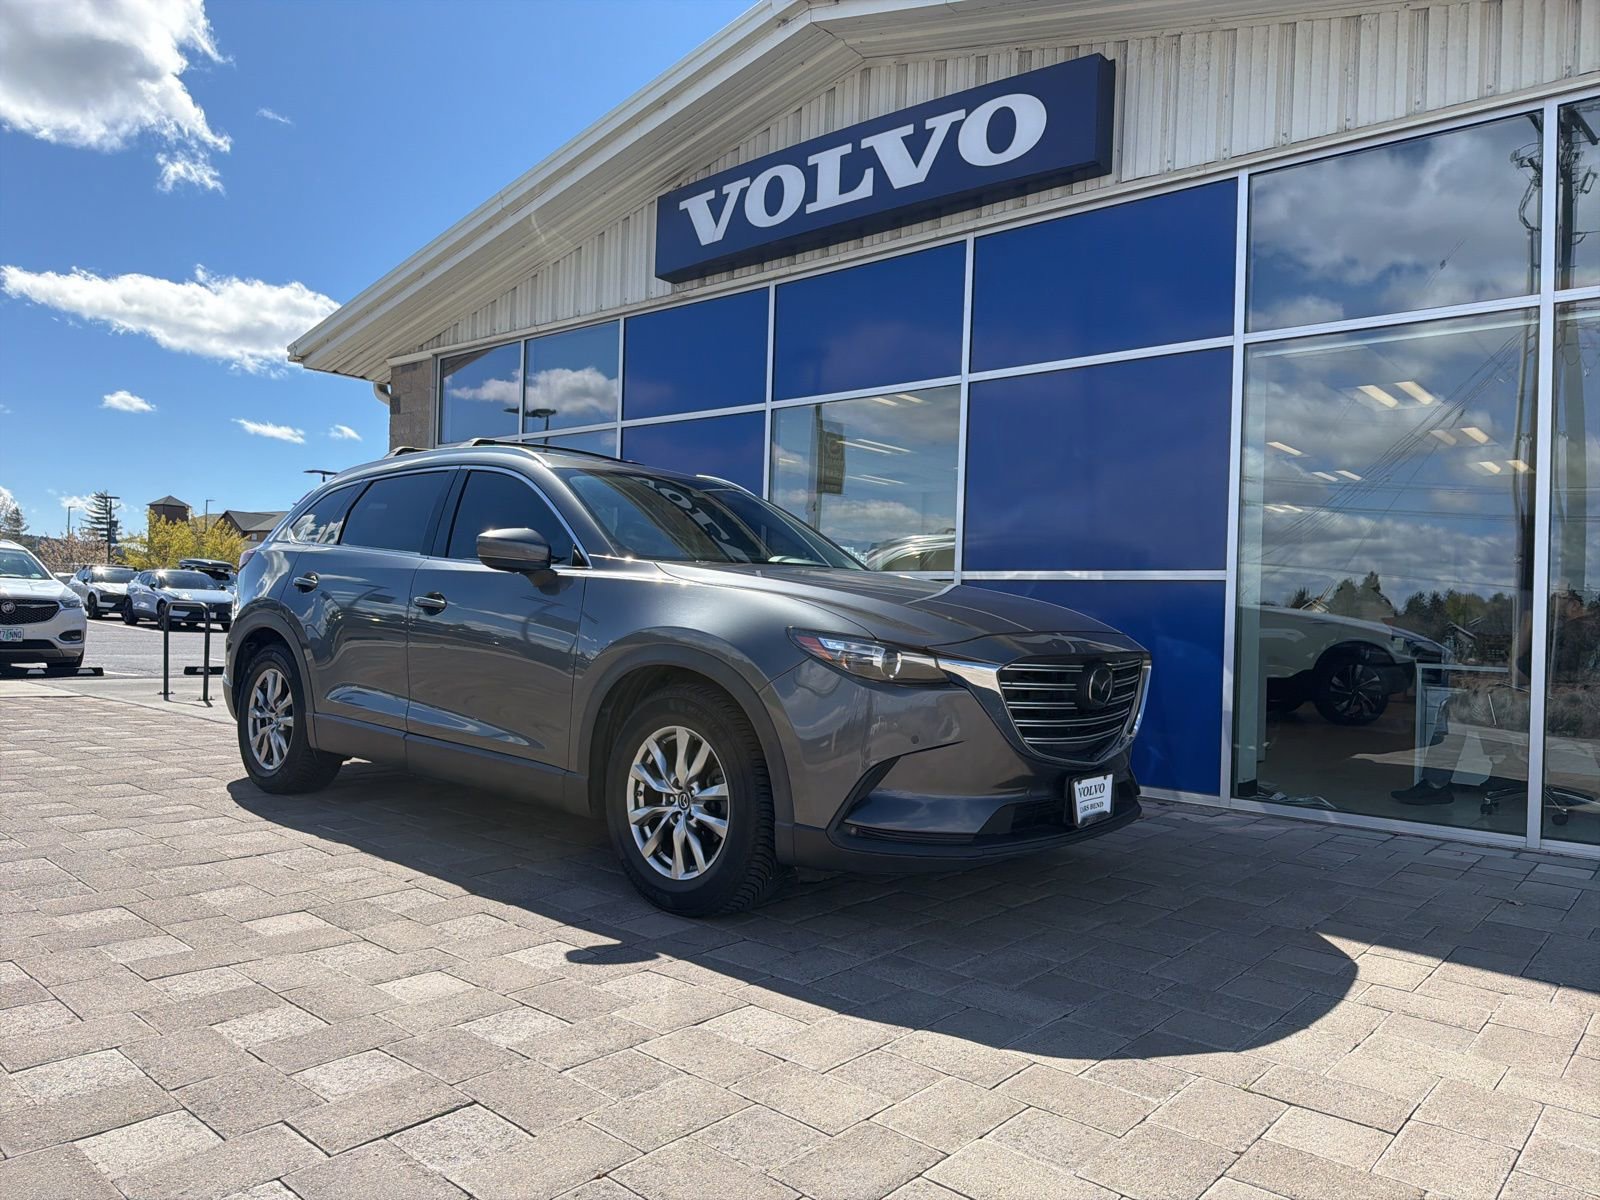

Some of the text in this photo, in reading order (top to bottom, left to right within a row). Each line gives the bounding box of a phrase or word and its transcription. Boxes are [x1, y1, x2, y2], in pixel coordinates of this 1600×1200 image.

[679, 93, 1047, 246] VOLVO
[1078, 783, 1105, 798] VOLVO
[1090, 801, 1104, 810] BEND
